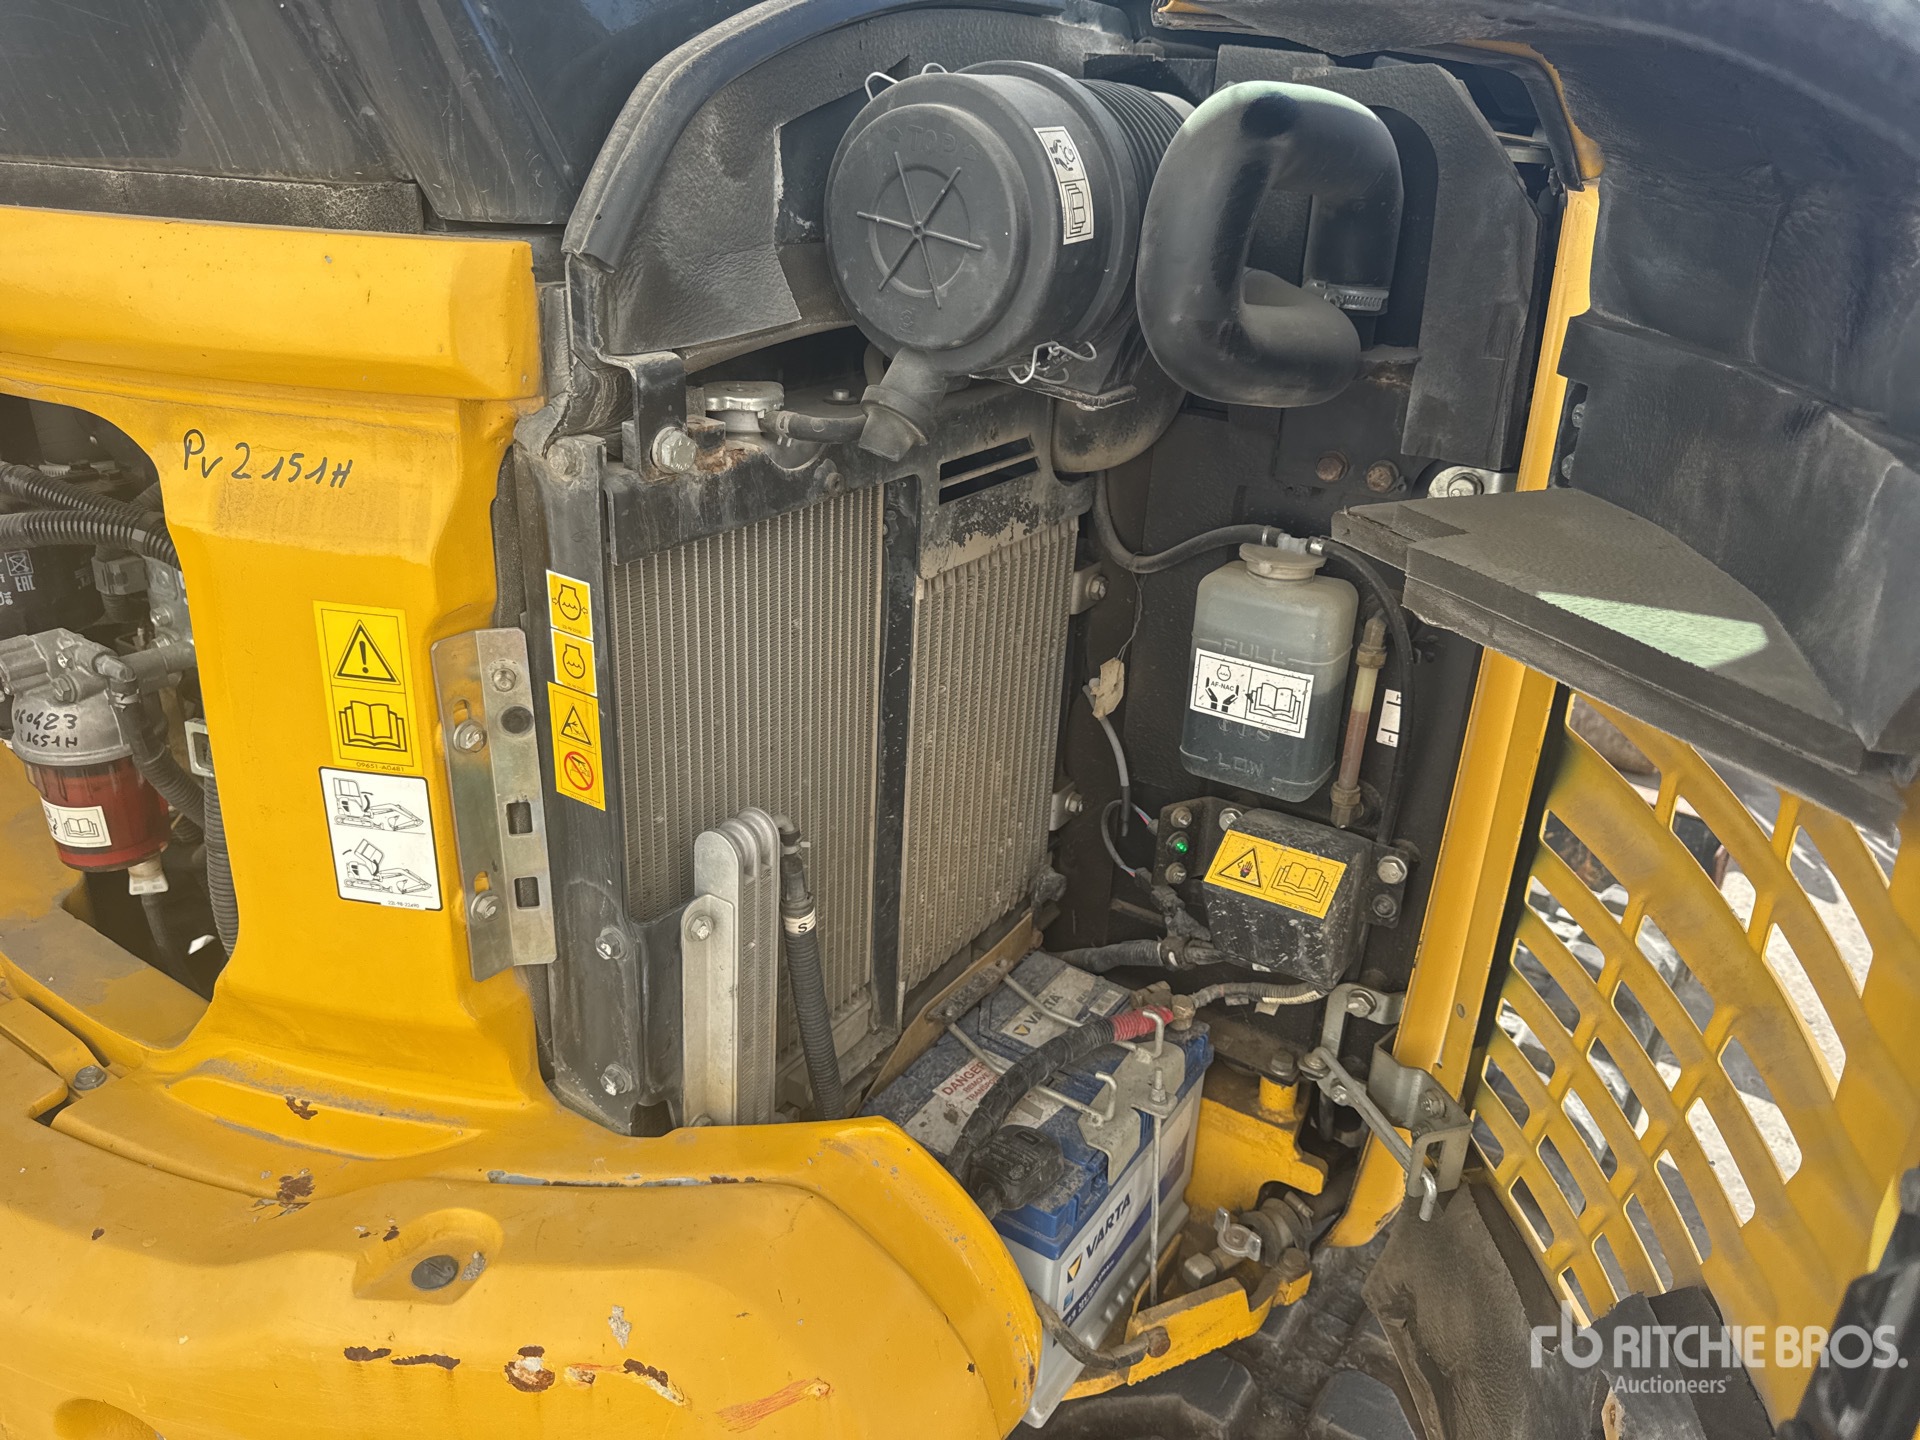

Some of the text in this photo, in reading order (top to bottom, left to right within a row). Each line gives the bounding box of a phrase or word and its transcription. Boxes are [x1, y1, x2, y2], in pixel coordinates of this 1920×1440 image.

[1223, 638, 1286, 666] FULL
[1210, 680, 1235, 692] AF-NAC
[1218, 752, 1264, 777] LOW
[797, 922, 808, 933] S
[941, 1061, 985, 1096] DANGER
[1085, 1192, 1132, 1259] VARTA
